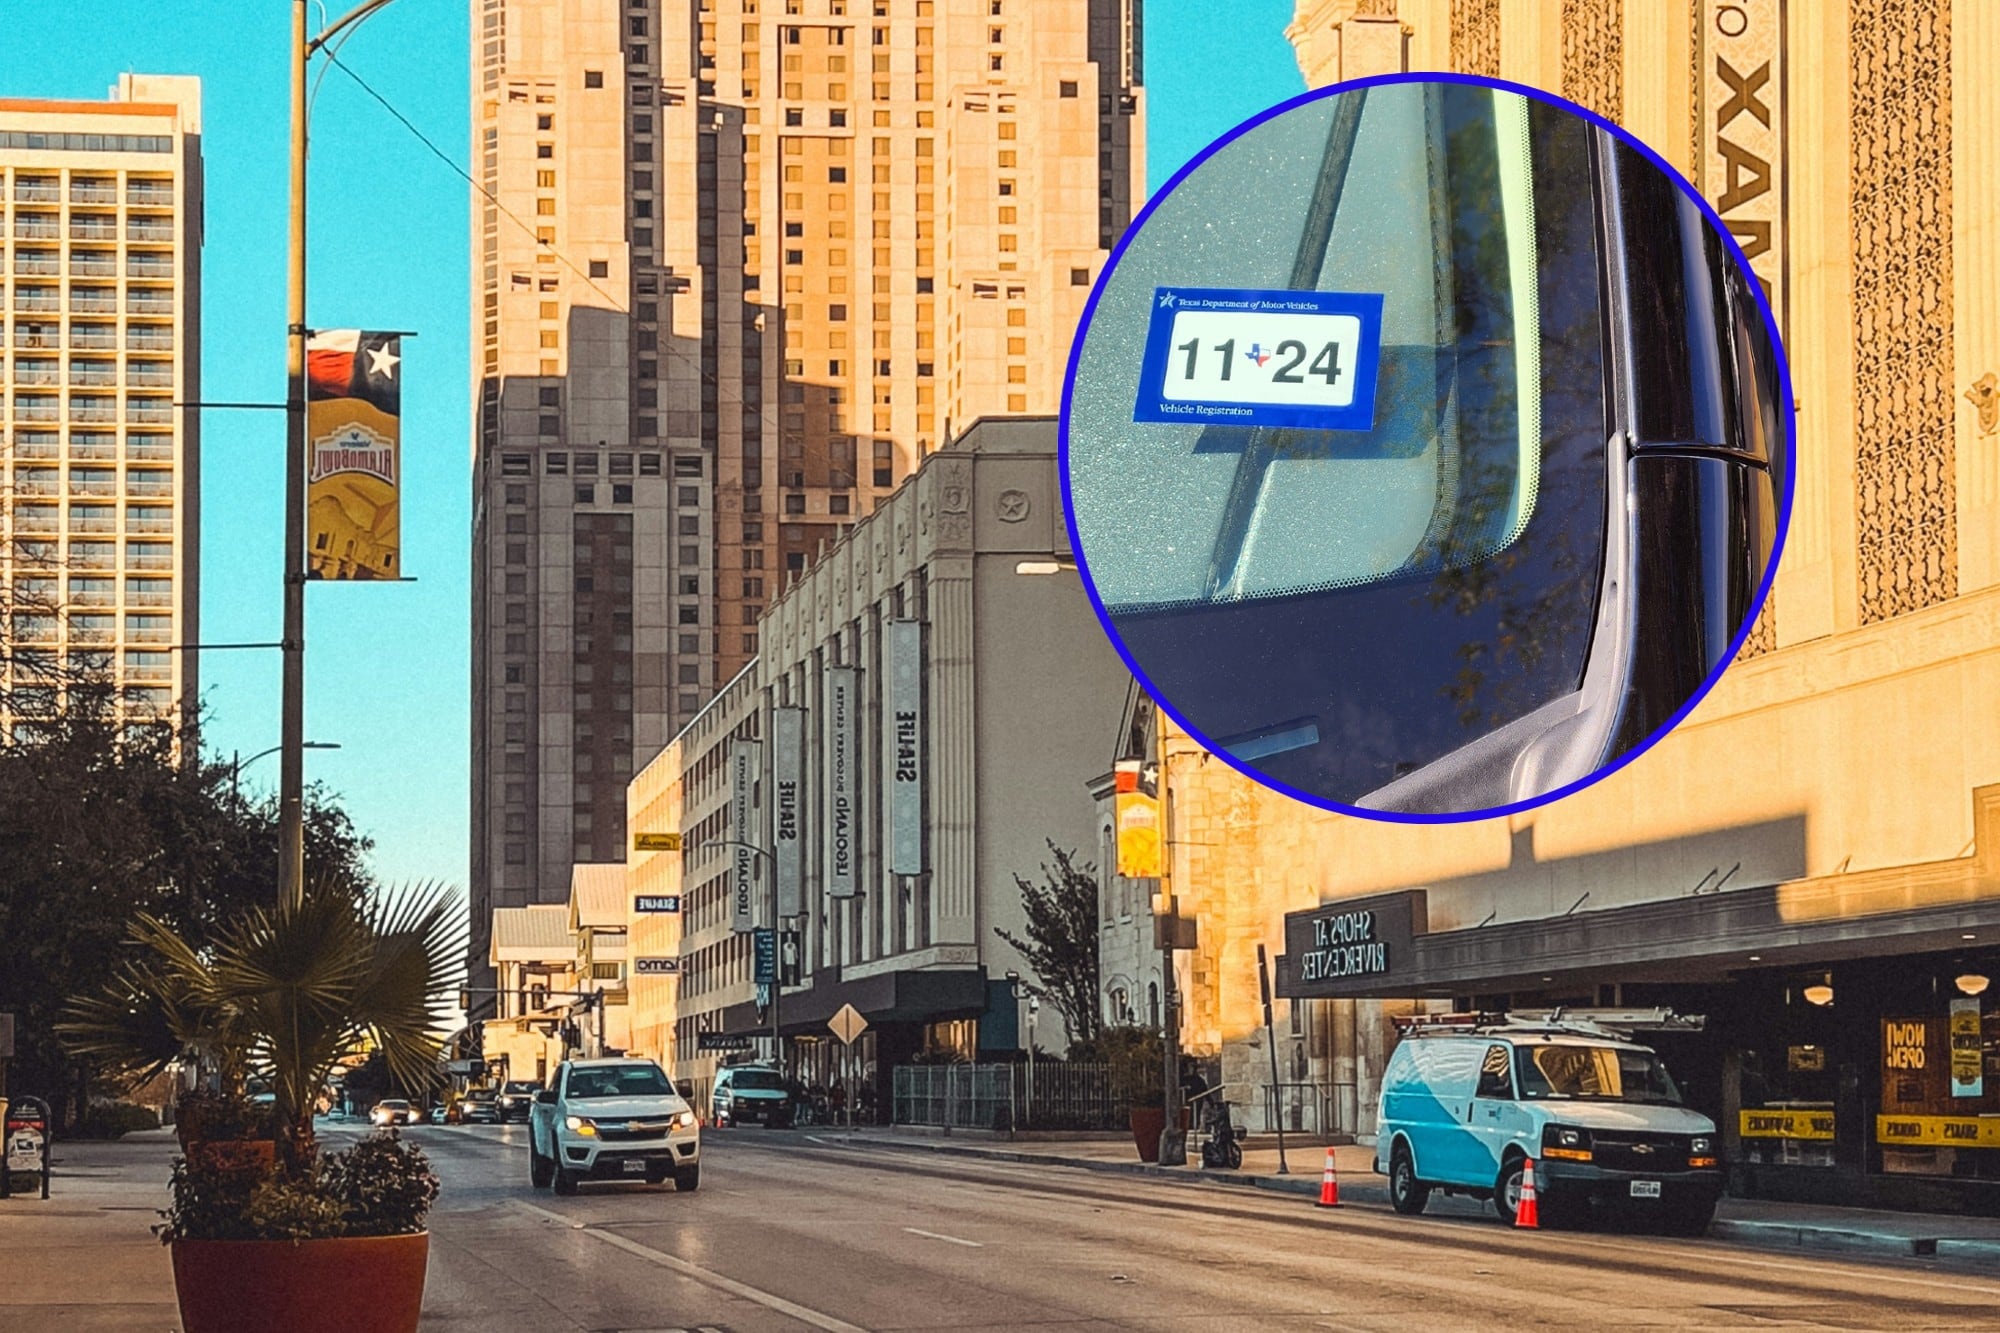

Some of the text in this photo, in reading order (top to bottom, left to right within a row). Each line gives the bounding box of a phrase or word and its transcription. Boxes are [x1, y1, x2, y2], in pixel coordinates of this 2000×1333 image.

[1178, 298, 1319, 311] Texas Department of Motor Vehicles
[1178, 337, 1342, 386] 11 24
[1160, 403, 1253, 416] Vehicle Registration
